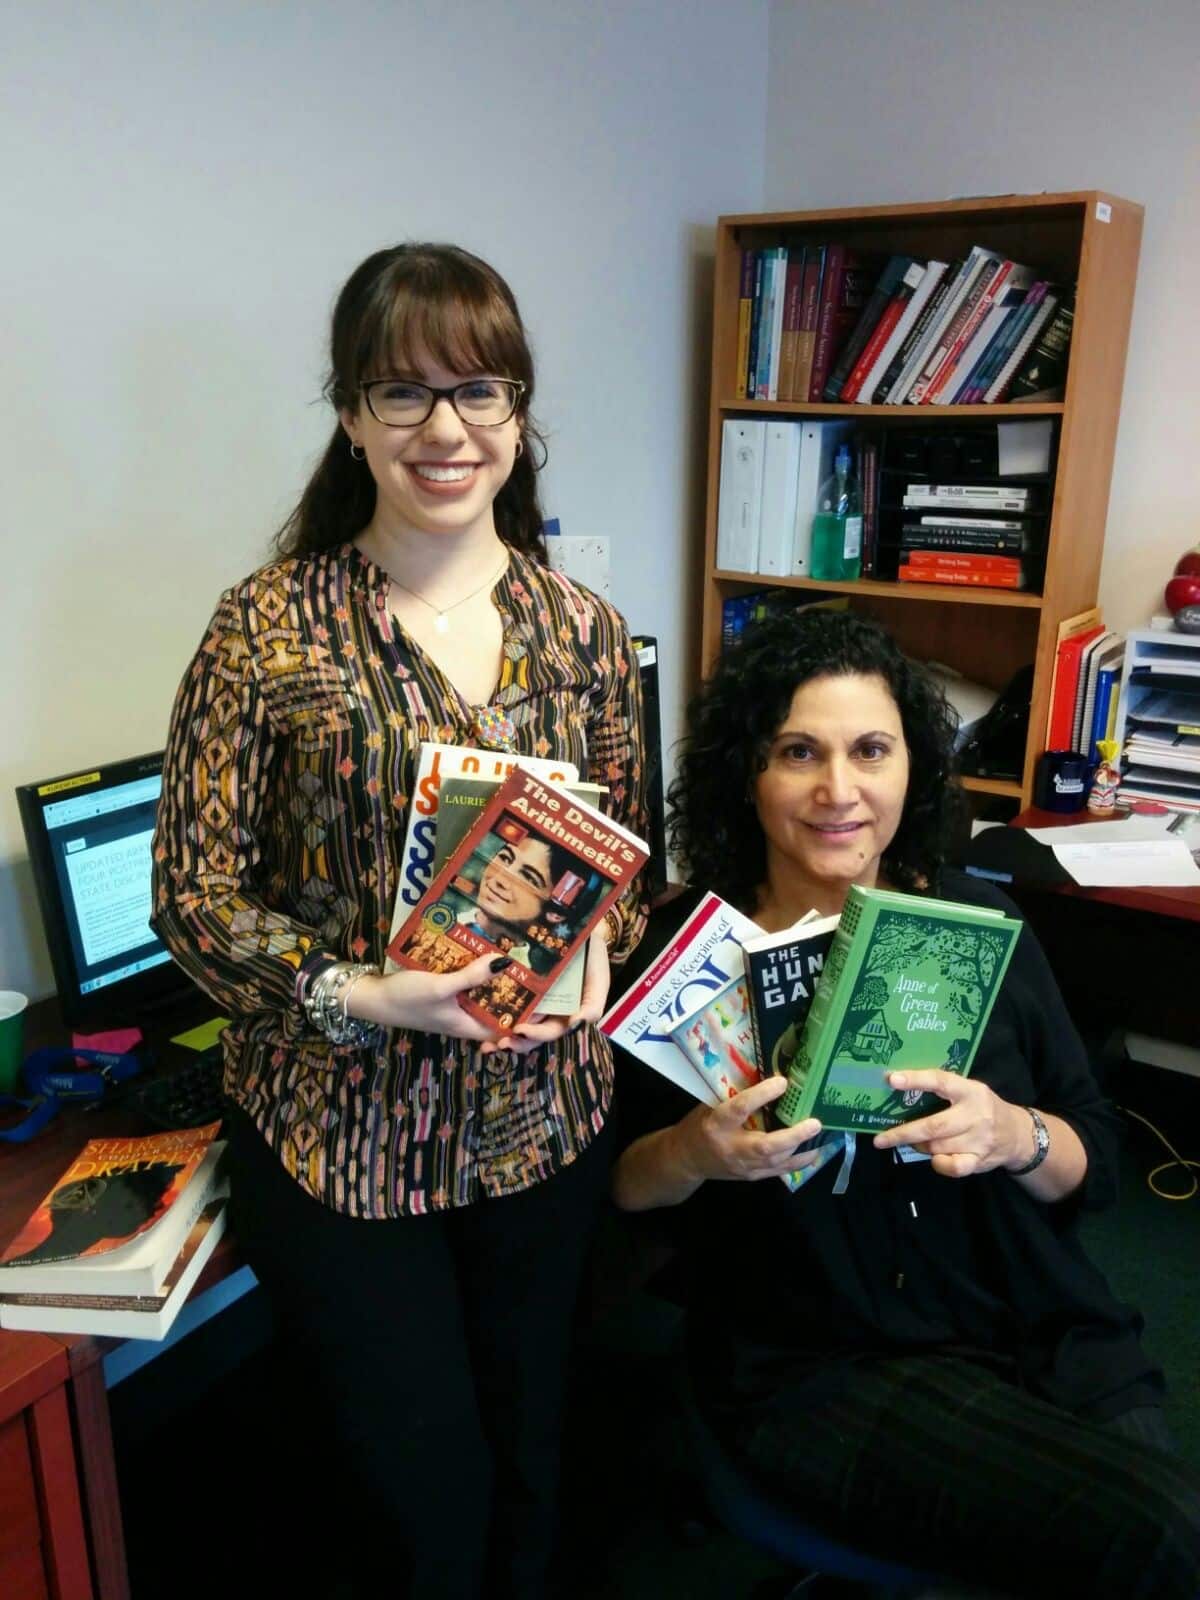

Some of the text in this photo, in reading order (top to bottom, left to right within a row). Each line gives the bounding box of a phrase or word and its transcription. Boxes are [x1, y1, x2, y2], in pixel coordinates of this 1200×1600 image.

[445, 794, 487, 807] LAURIE
[522, 777, 637, 863] The Devil's
[510, 797, 624, 877] Arithmetic
[453, 928, 485, 953] JANE
[767, 946, 800, 964] THE
[625, 916, 730, 1037] The Care & Keeping of
[761, 953, 824, 987] HUN
[893, 973, 939, 994] Anne of
[900, 992, 939, 1013] Green
[906, 1012, 949, 1032] Gables
[67, 1146, 209, 1177] DRAPER
